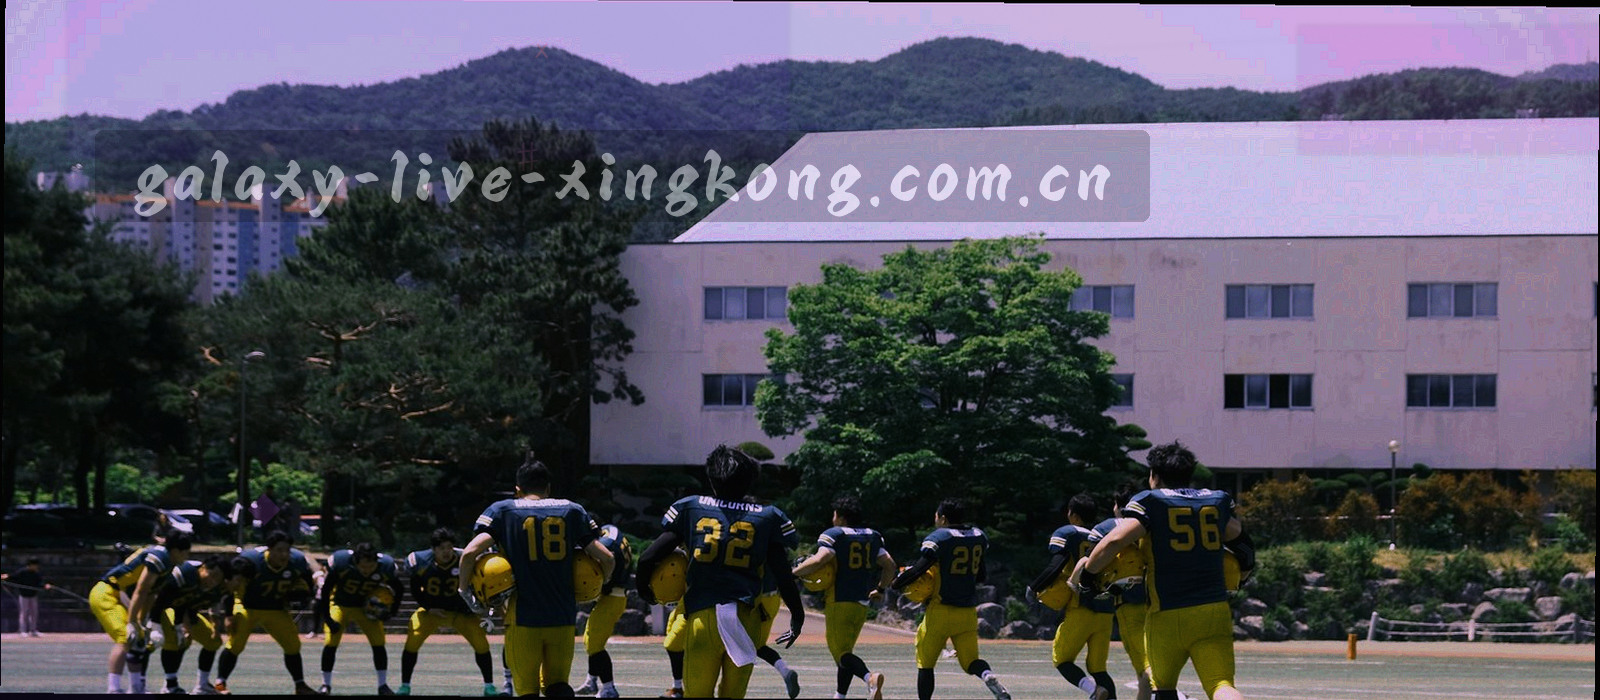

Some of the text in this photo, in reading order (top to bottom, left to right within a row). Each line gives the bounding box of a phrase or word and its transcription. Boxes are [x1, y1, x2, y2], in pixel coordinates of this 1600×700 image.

[523, 516, 566, 561] 18
[693, 517, 755, 567] 32
[1168, 505, 1221, 551] 56
[848, 541, 872, 569] 61
[950, 544, 983, 575] 28
[426, 576, 458, 597] 63
